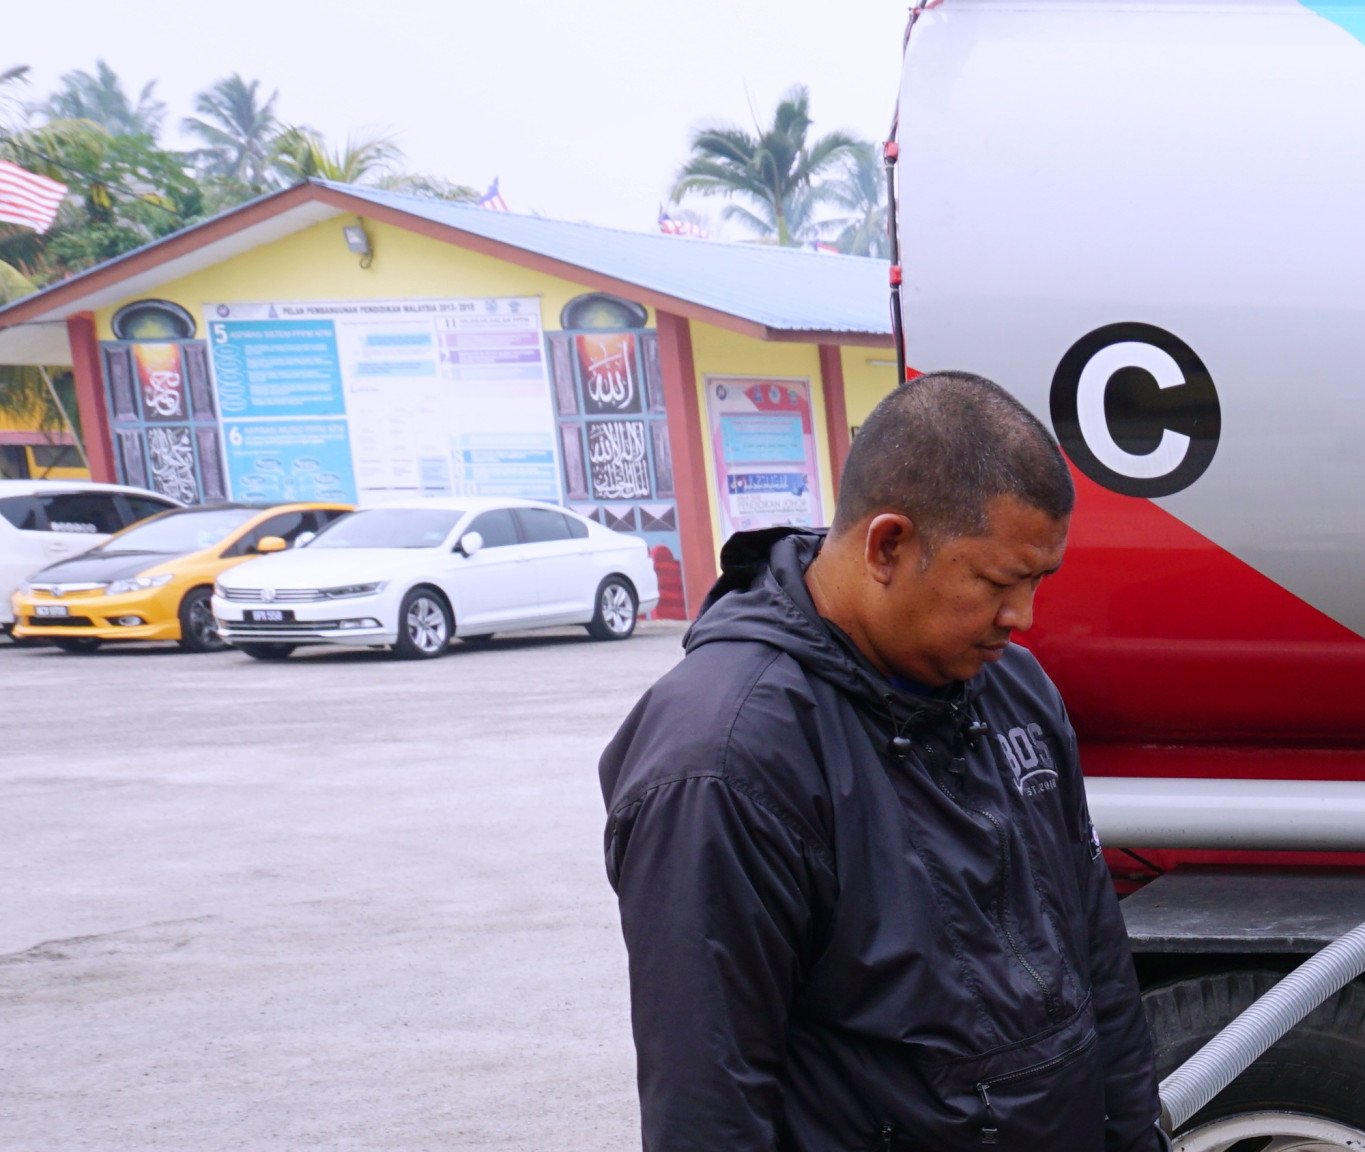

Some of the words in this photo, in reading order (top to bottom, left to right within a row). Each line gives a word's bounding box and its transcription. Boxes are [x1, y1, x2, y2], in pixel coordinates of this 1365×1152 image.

[283, 307, 304, 316] PELAN
[306, 306, 358, 315] PEMBANGUNAN
[360, 304, 401, 314] PENDIDIKAN
[404, 303, 437, 313] MALAYSIA
[213, 324, 228, 344] 5
[1077, 341, 1191, 479] C
[229, 426, 243, 446] 6
